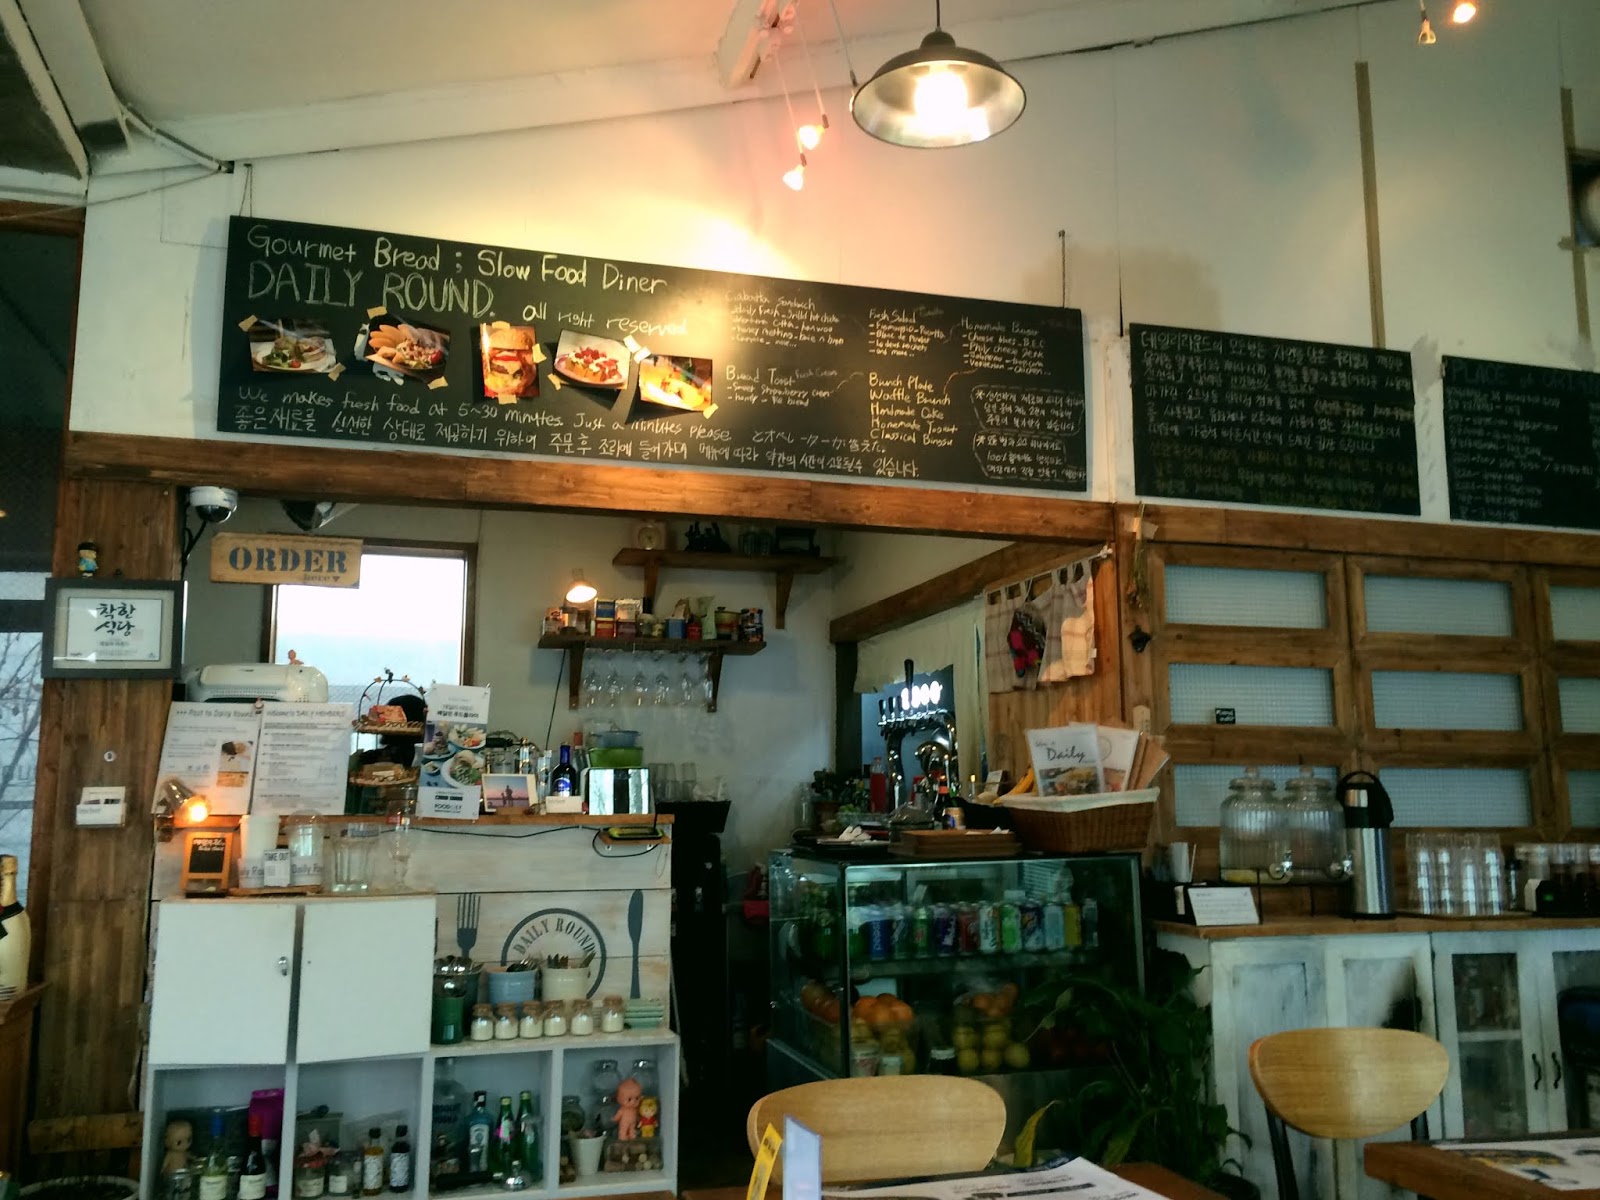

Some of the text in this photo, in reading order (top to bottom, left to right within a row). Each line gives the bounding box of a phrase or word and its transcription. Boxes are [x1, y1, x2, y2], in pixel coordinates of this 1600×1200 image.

[247, 224, 357, 263] Gourmet
[373, 236, 440, 271] Bread
[477, 249, 531, 281] Slow
[541, 254, 588, 288] Food
[602, 262, 668, 295] Diner
[247, 259, 364, 307] DAILY
[557, 310, 596, 330] right
[605, 314, 689, 338] reserved
[238, 386, 268, 403] We
[282, 391, 334, 408] makes
[341, 391, 380, 412] fresh
[386, 393, 421, 415] food
[428, 402, 449, 416] at
[573, 412, 606, 432] Just
[612, 419, 625, 431] a
[869, 386, 911, 404] Waffle
[332, 410, 373, 436] 신선한
[383, 416, 426, 442] 상태로
[435, 421, 488, 444] 제공하기
[869, 428, 917, 444] Classical
[228, 546, 348, 574] ORDER
[95, 602, 137, 620] 착한
[94, 620, 136, 637] 식당
[1045, 745, 1086, 763] Daily
[513, 917, 596, 955] DAILY ROUND
